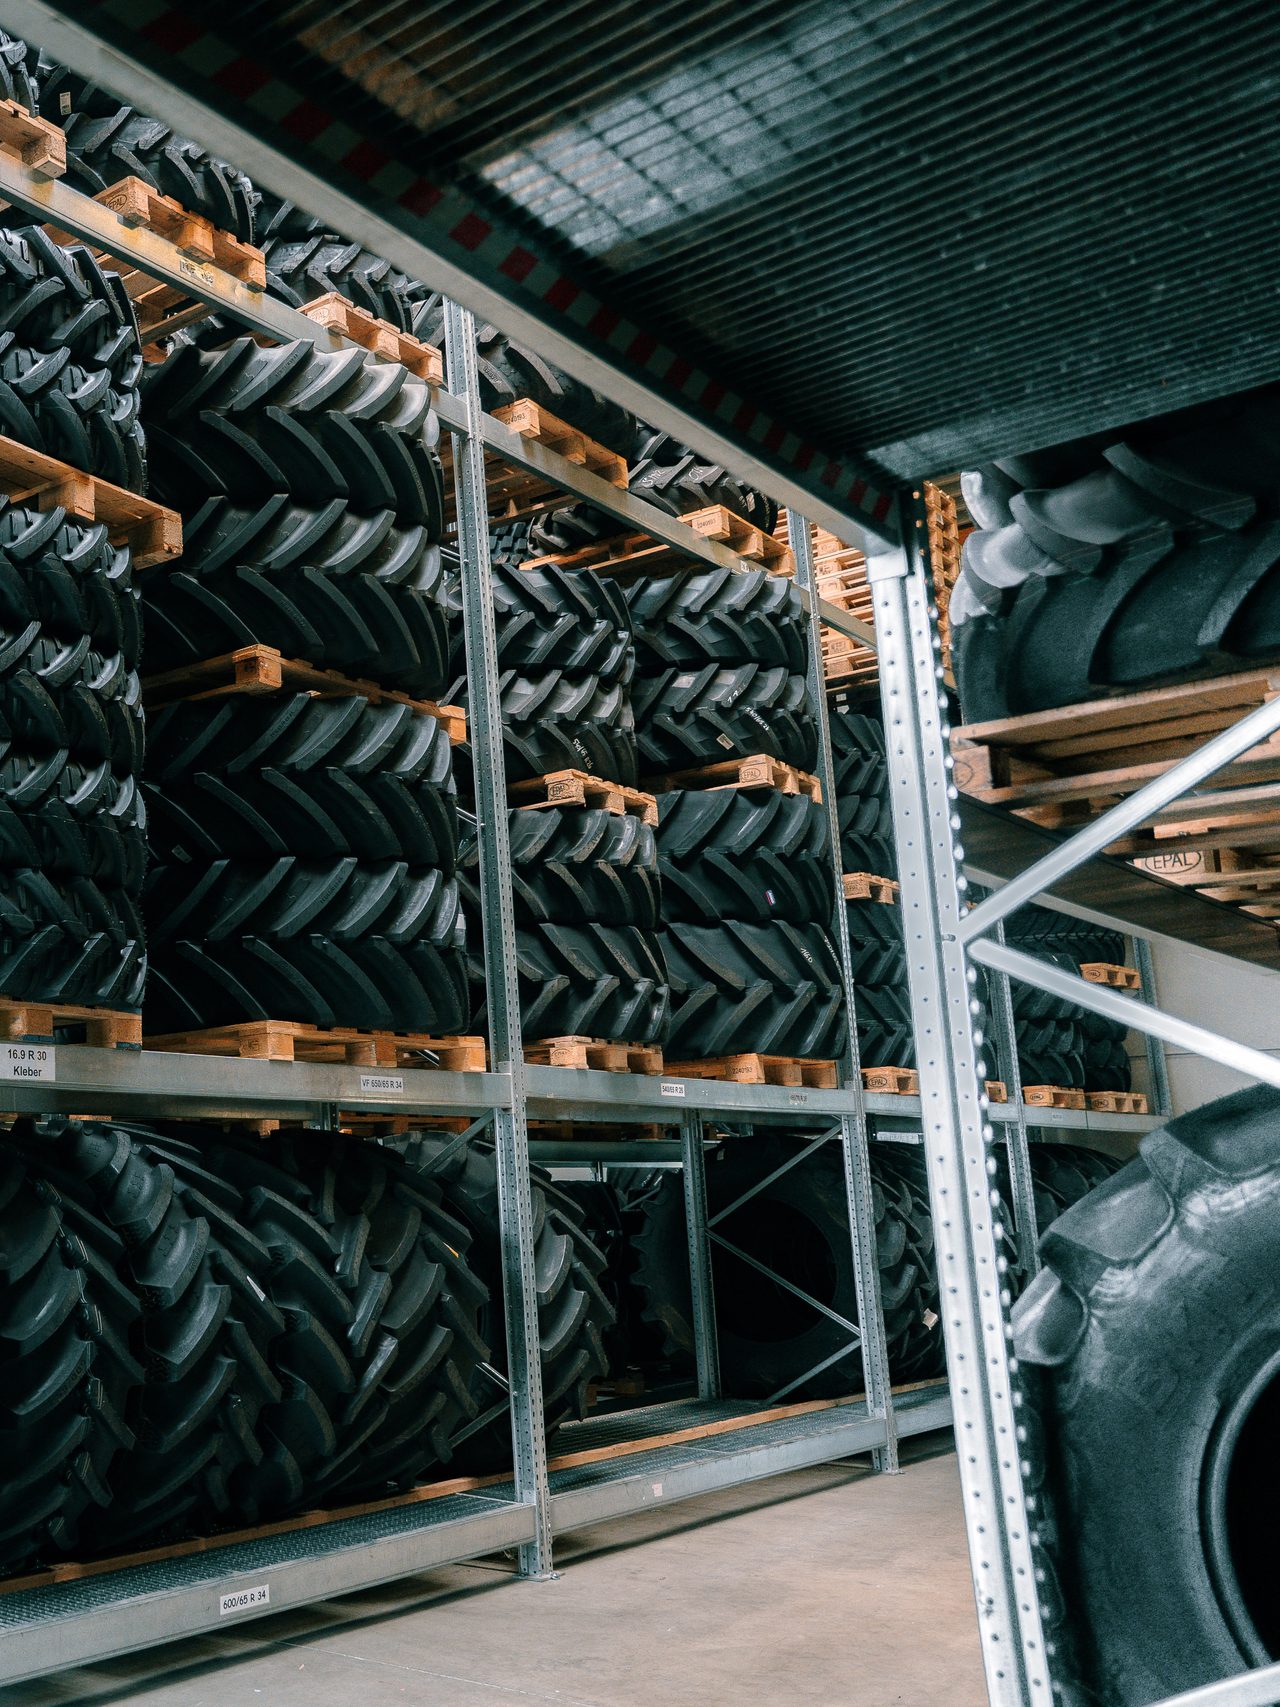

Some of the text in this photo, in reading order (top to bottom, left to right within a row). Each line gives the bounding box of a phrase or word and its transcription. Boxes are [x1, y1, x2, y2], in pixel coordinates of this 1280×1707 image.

[1153, 851, 1193, 869] EPAL
[7, 1049, 47, 1061] 16.9 R 30
[13, 1066, 43, 1077] Kleber
[362, 1079, 370, 1088] VF
[390, 1080, 395, 1089] R
[223, 1589, 266, 1610] 600/65 R 34
